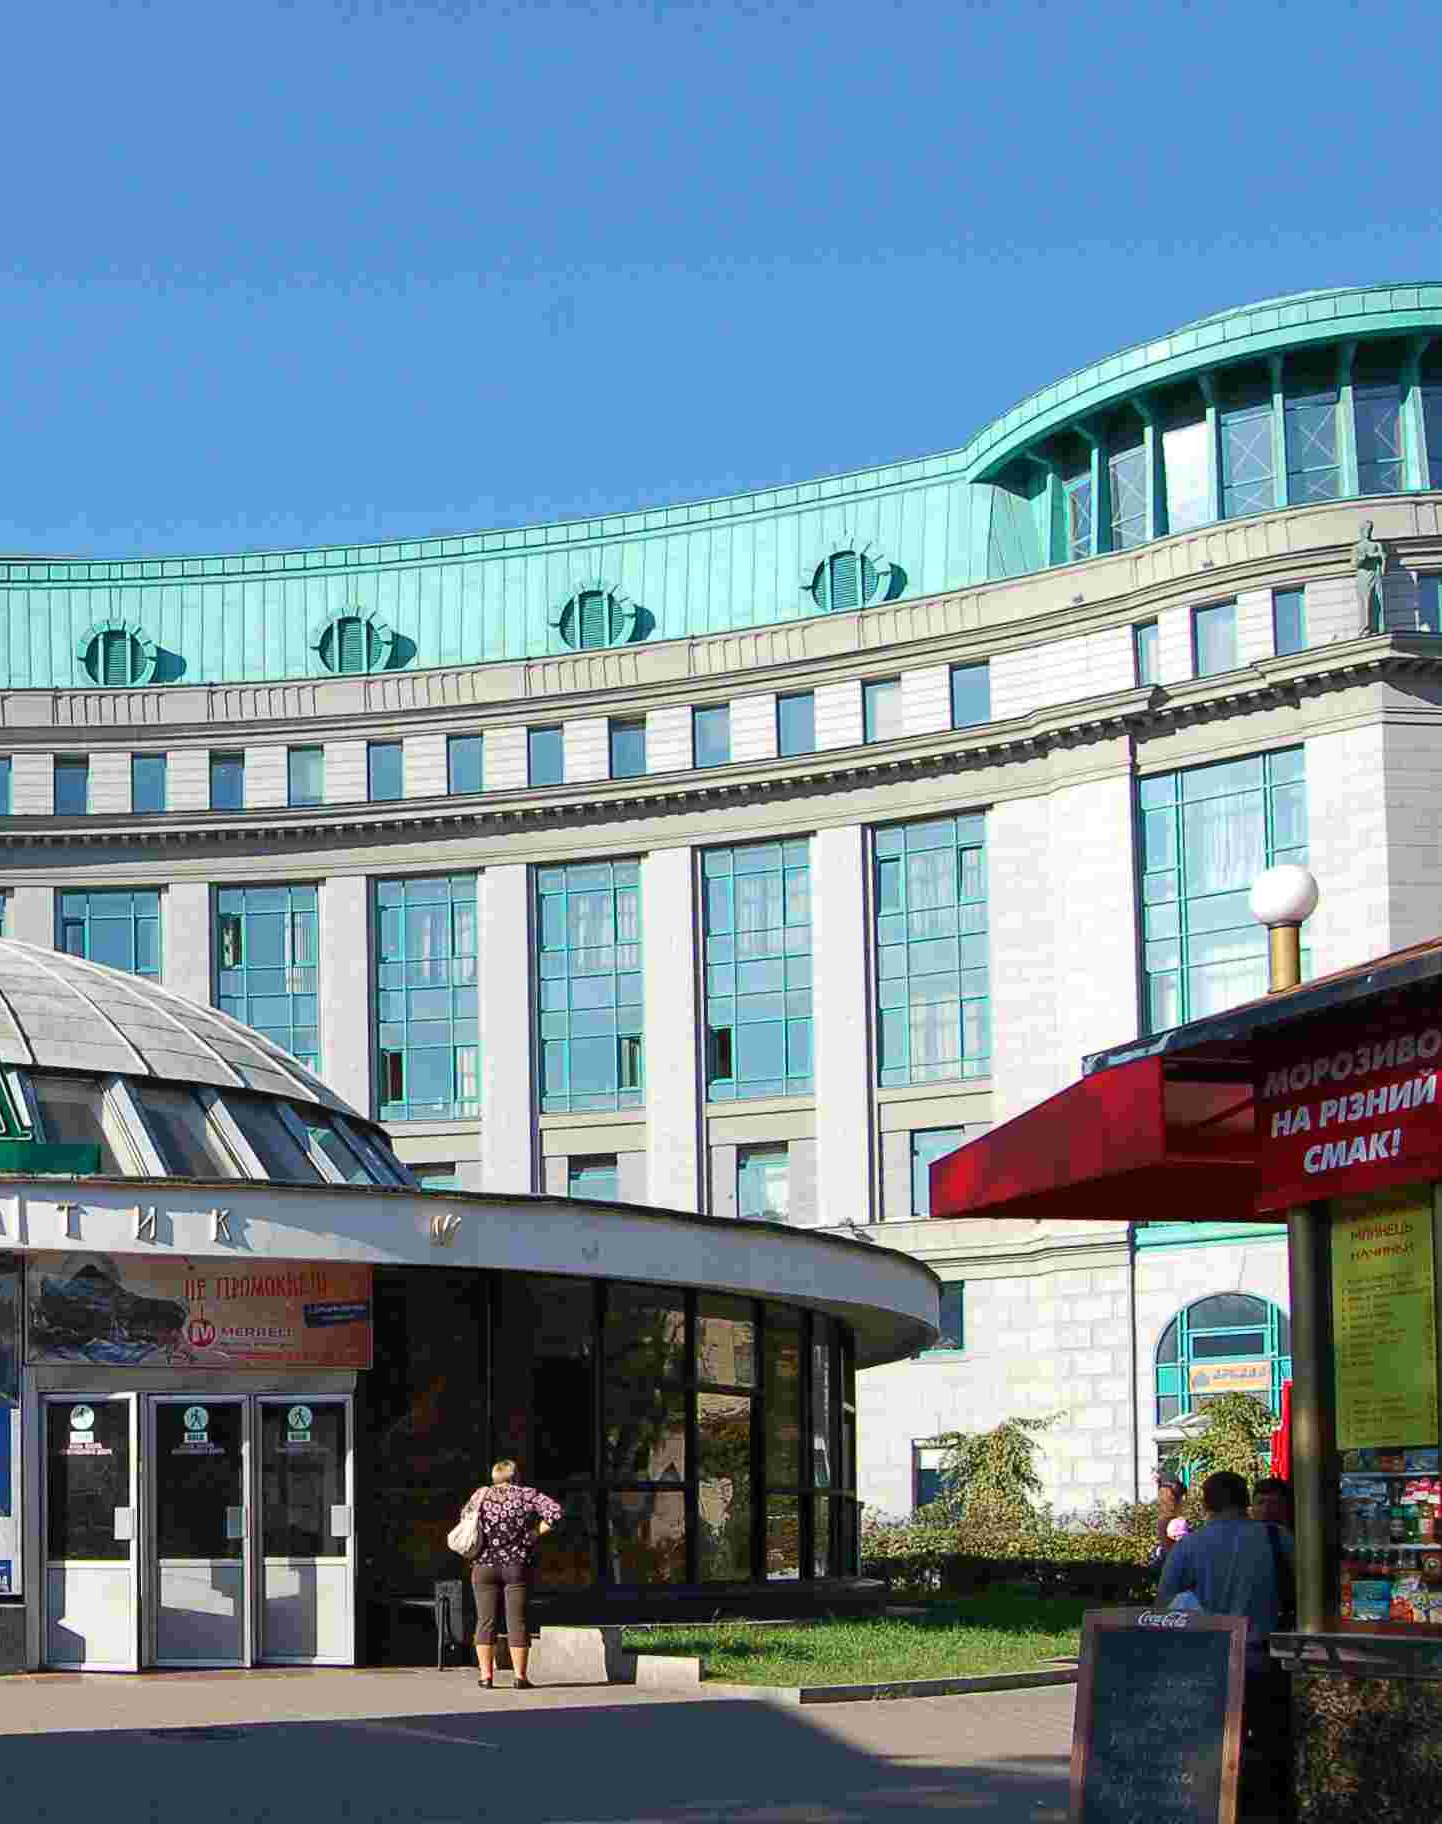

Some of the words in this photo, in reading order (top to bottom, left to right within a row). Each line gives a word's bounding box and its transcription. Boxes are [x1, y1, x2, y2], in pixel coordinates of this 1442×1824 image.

[1262, 1028, 1442, 1098] МОРОЗИВО
[1271, 1105, 1311, 1138] НА
[1319, 1068, 1438, 1128] РІЗНИЙ
[1303, 1127, 1401, 1174] СМАК!
